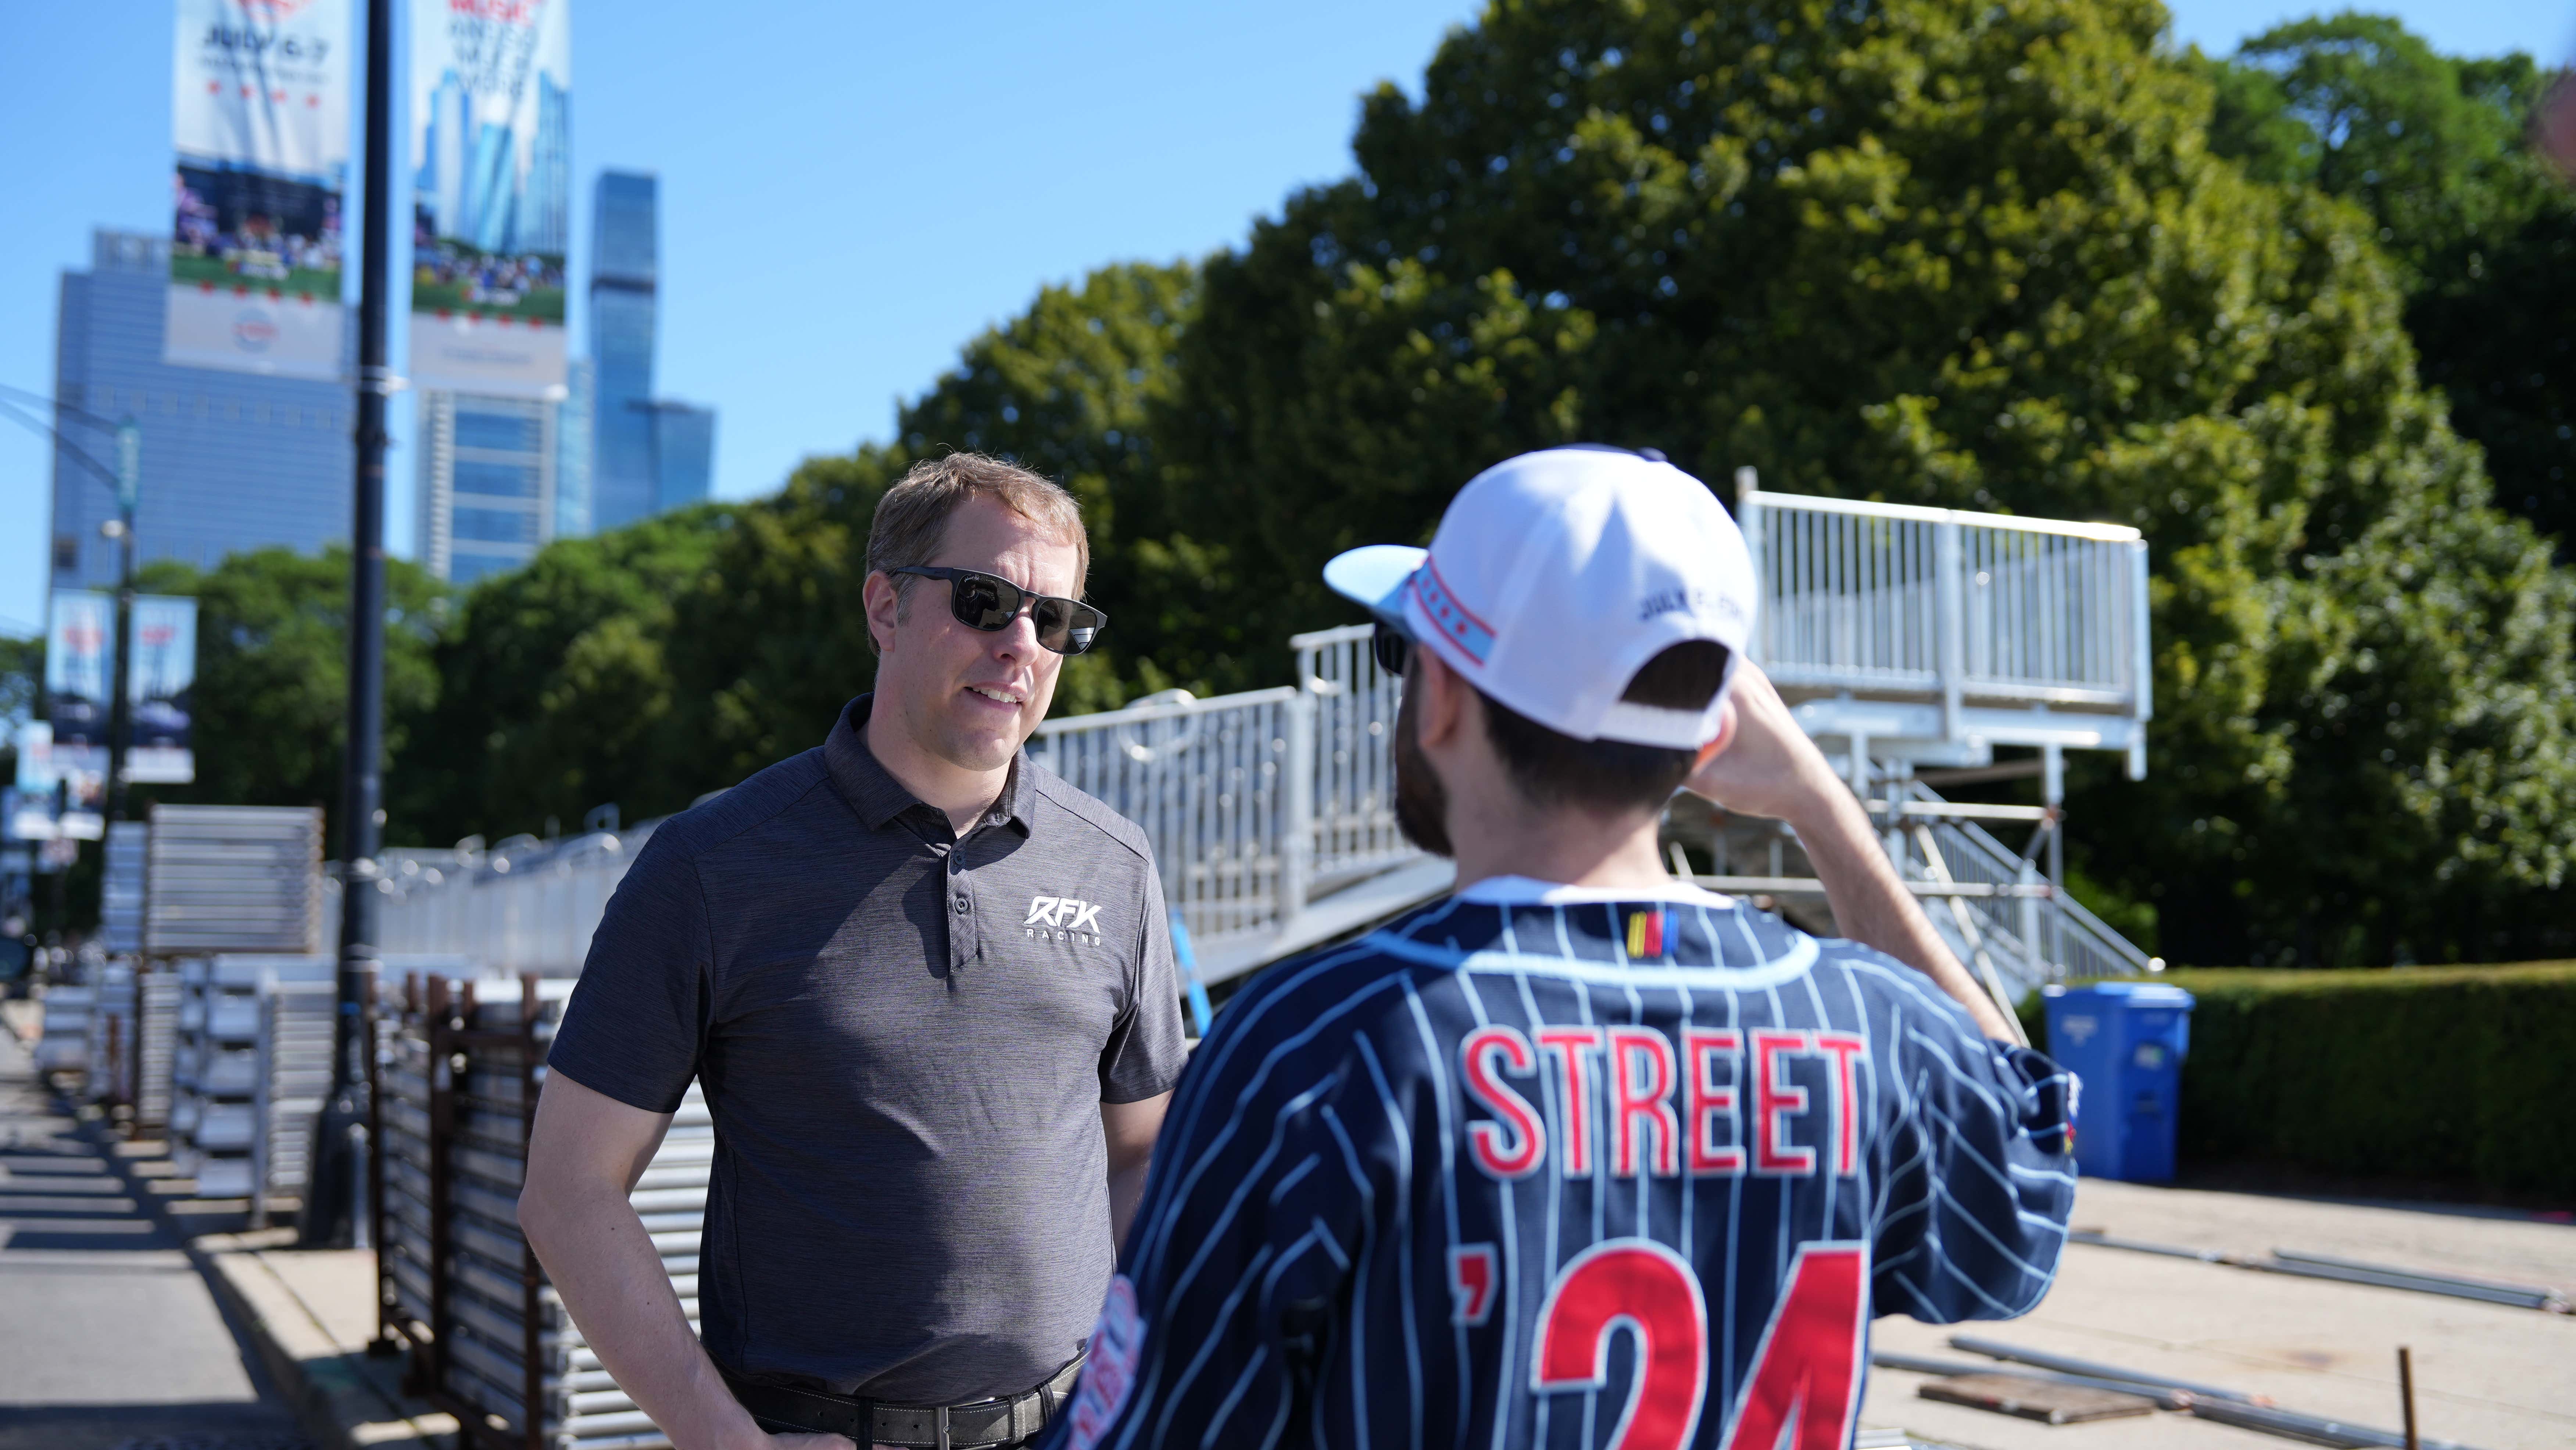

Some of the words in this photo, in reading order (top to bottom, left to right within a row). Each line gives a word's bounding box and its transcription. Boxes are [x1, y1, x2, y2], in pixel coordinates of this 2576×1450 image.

[203, 25, 275, 55] JULY
[1024, 896, 1102, 934] RFK
[1027, 929, 1101, 946] RACING
[1461, 1024, 1868, 1178] STREET
